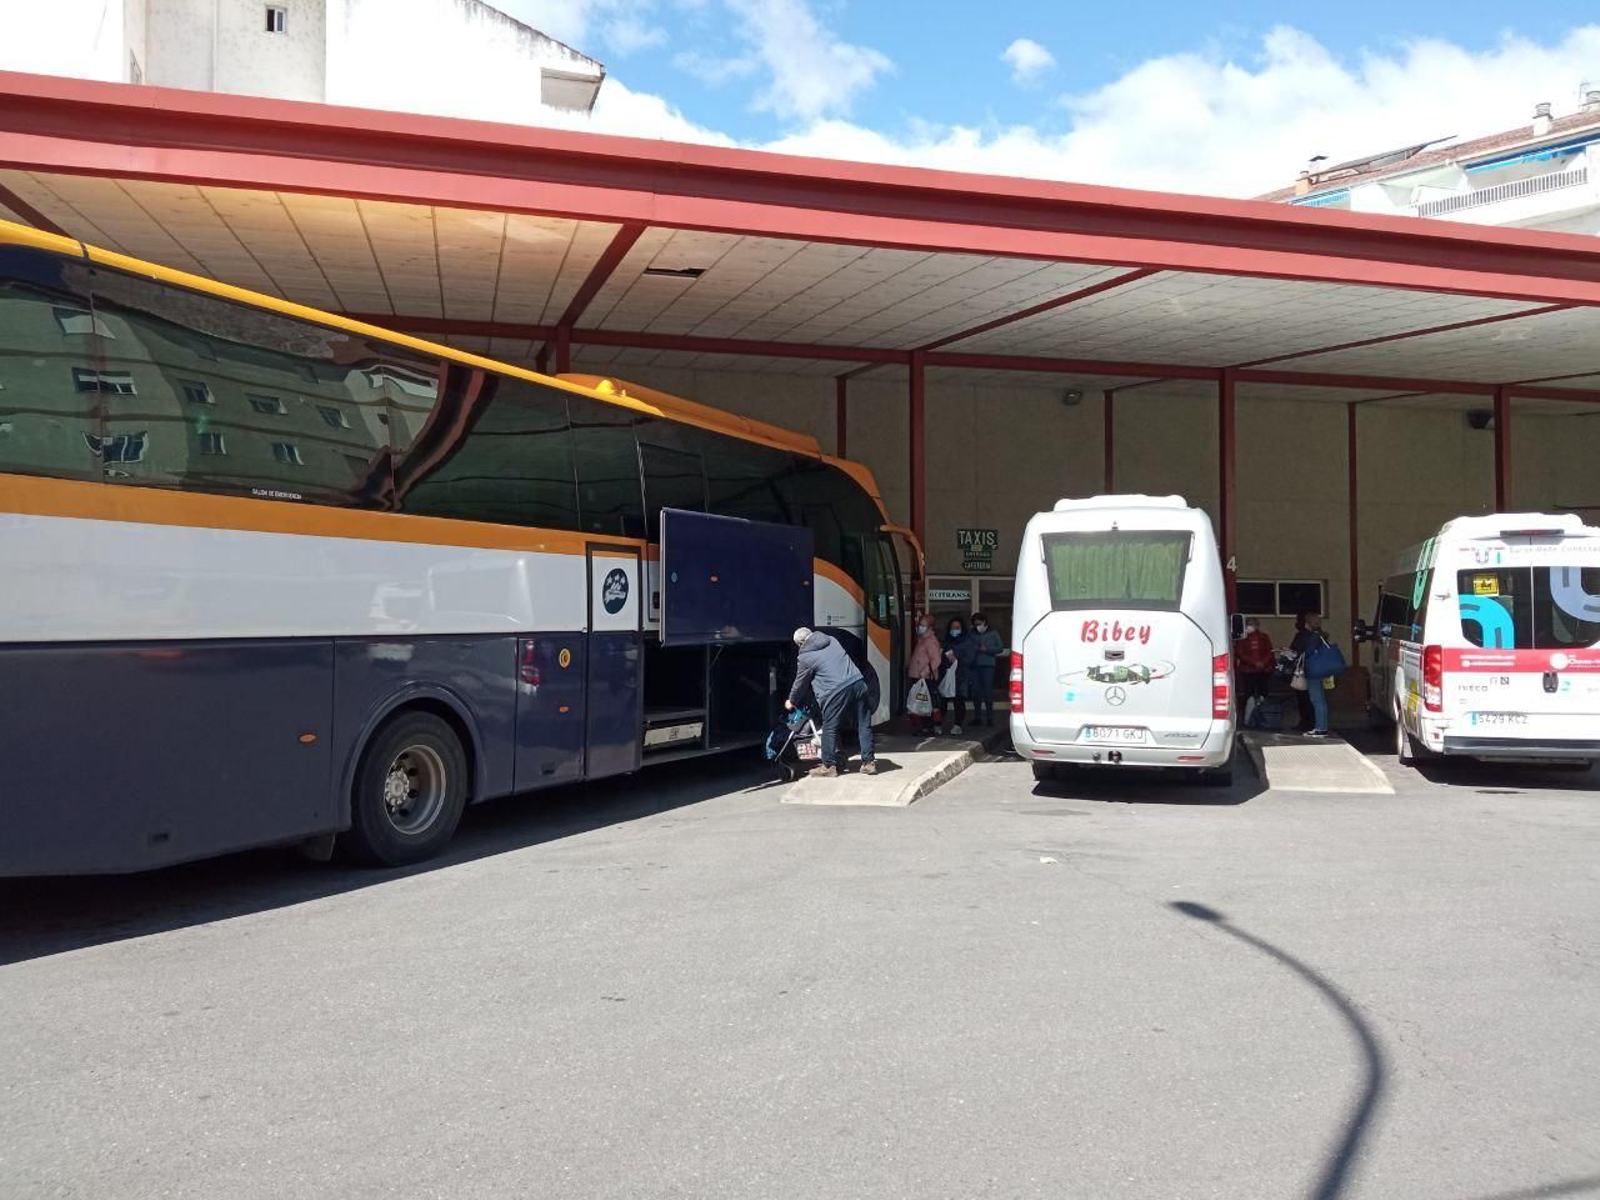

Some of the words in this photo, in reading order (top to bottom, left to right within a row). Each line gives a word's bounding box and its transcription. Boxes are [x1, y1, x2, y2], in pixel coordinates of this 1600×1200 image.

[959, 530, 995, 546] TAXIS
[1226, 555, 1237, 572] 4
[1080, 619, 1151, 645] Bibey
[1458, 684, 1488, 692] IVECO
